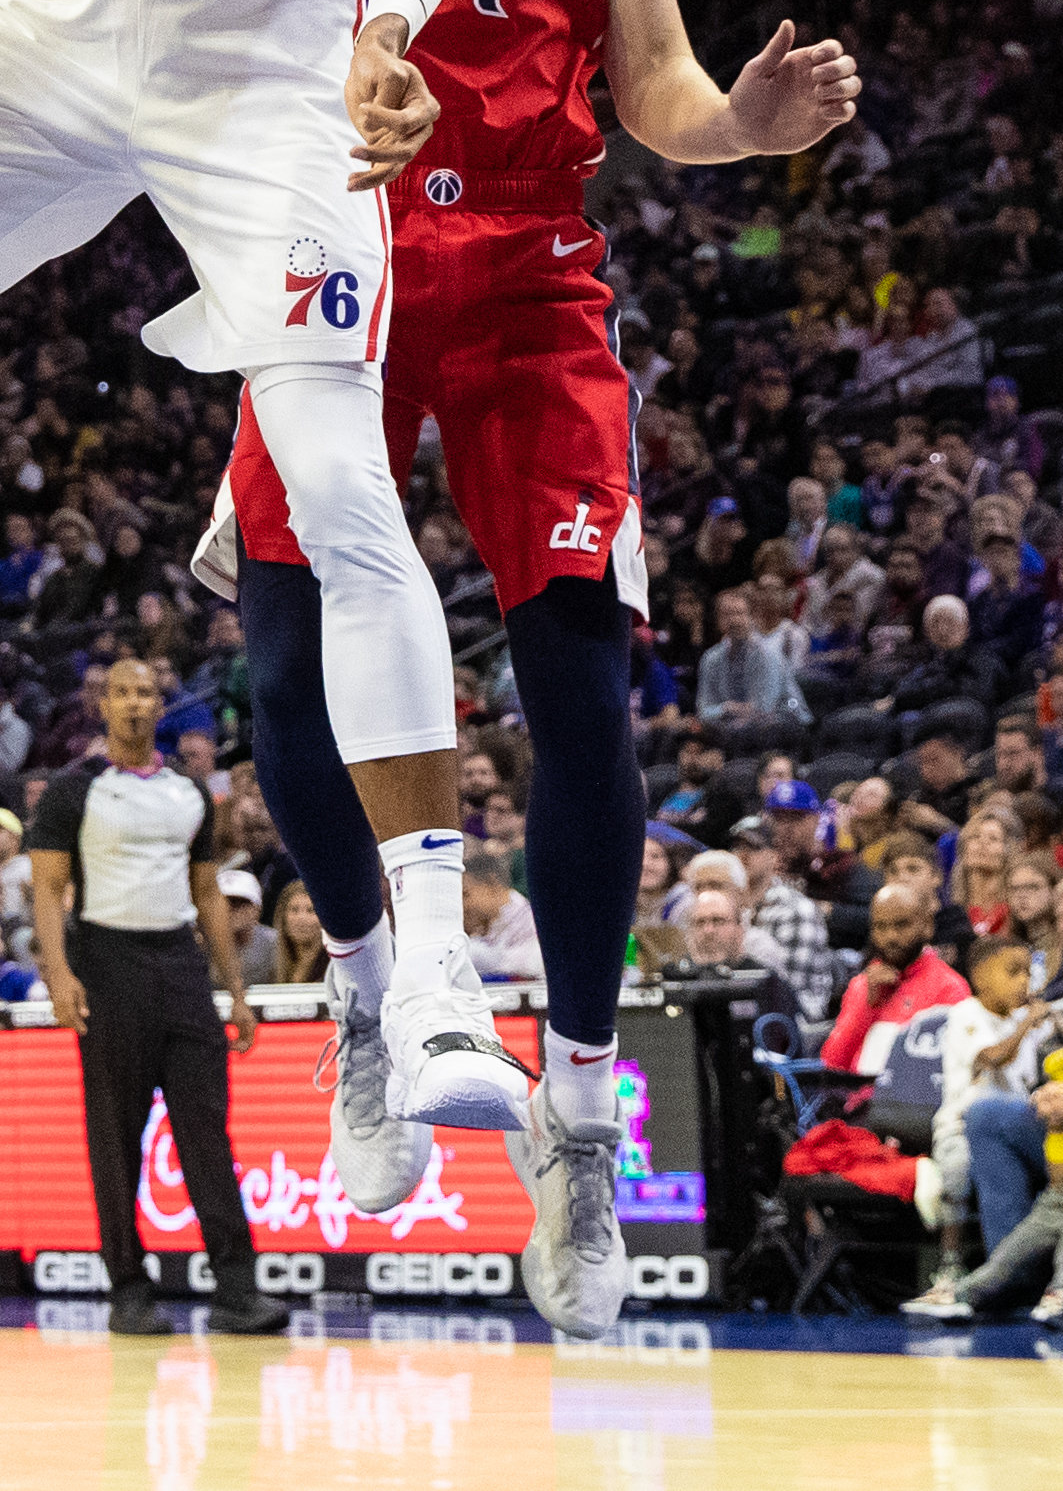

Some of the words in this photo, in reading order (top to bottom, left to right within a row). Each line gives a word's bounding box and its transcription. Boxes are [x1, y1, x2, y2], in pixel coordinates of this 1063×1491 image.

[285, 269, 361, 330] 76
[549, 502, 602, 553] dc
[366, 1252, 514, 1296] GEICO
